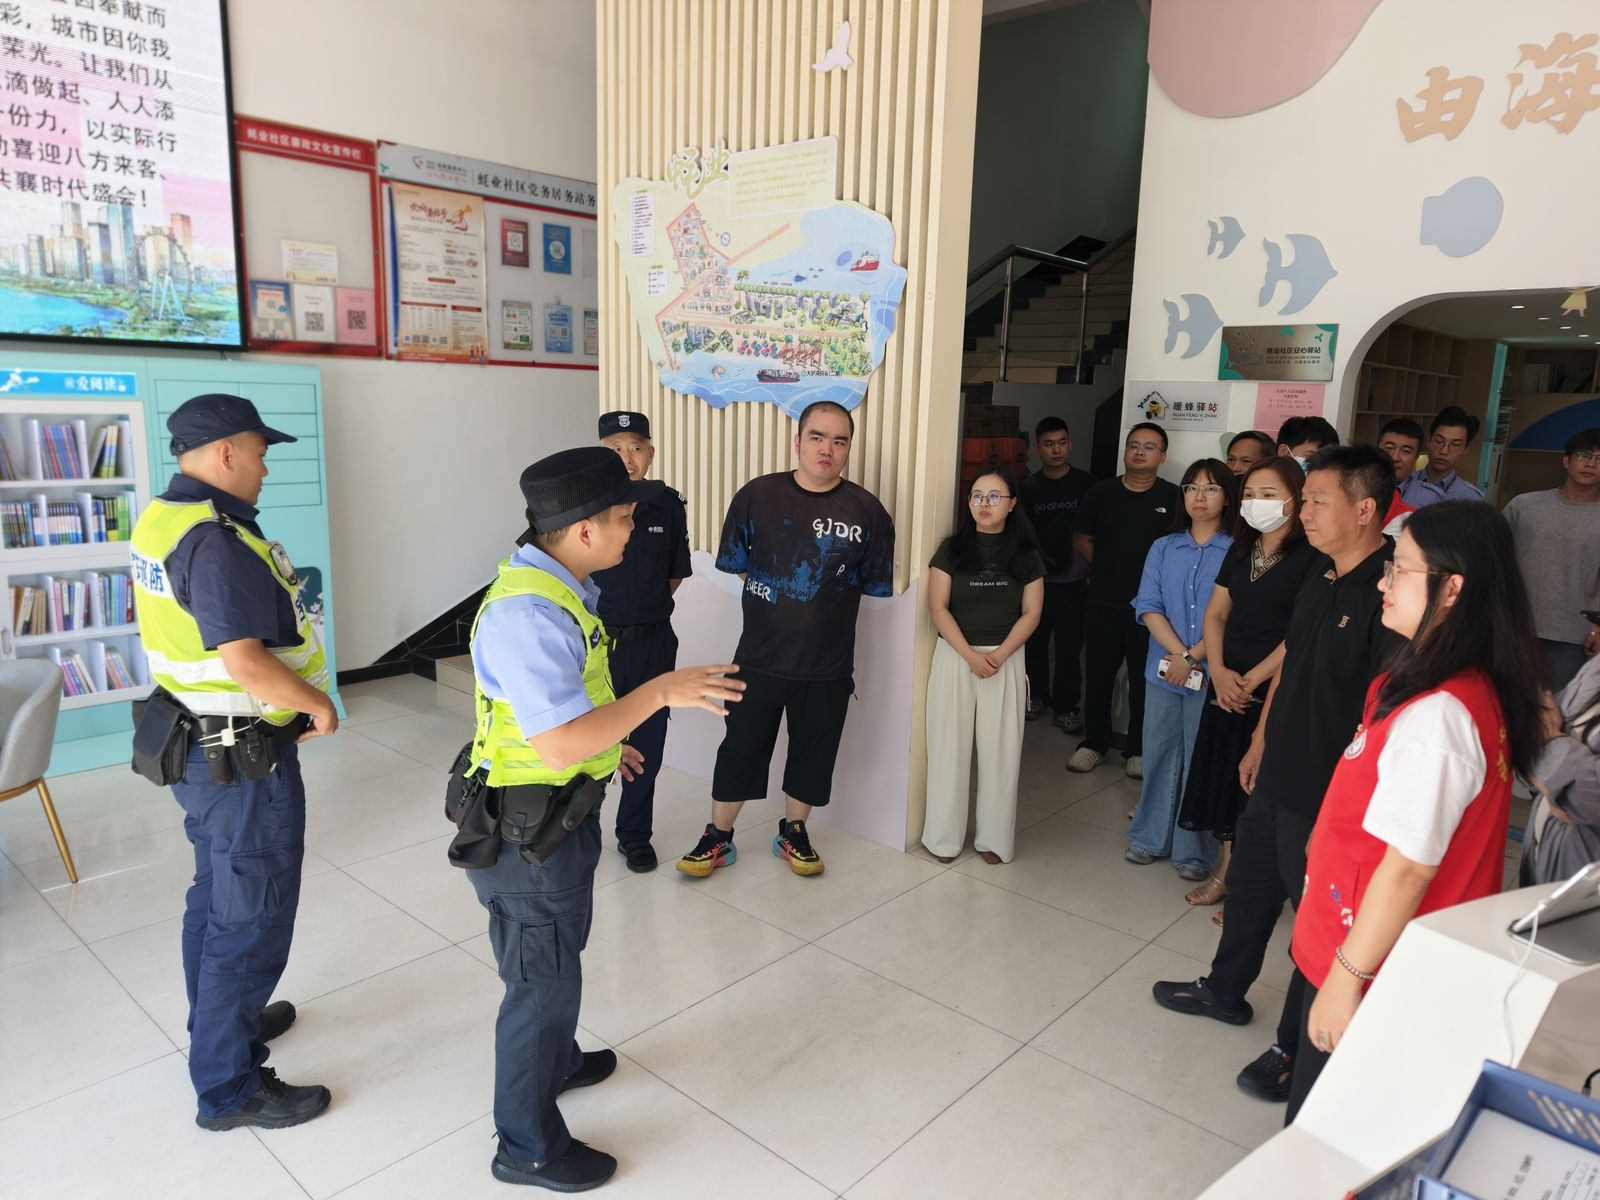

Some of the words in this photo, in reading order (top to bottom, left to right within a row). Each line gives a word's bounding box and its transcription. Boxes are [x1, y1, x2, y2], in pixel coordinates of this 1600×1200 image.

[59, 0, 166, 28] 因奉献而
[0, 69, 175, 121] 滴做起、人人添
[0, 104, 177, 152] 份力，以实际行
[1173, 401, 1218, 413] 暖蜂驿站
